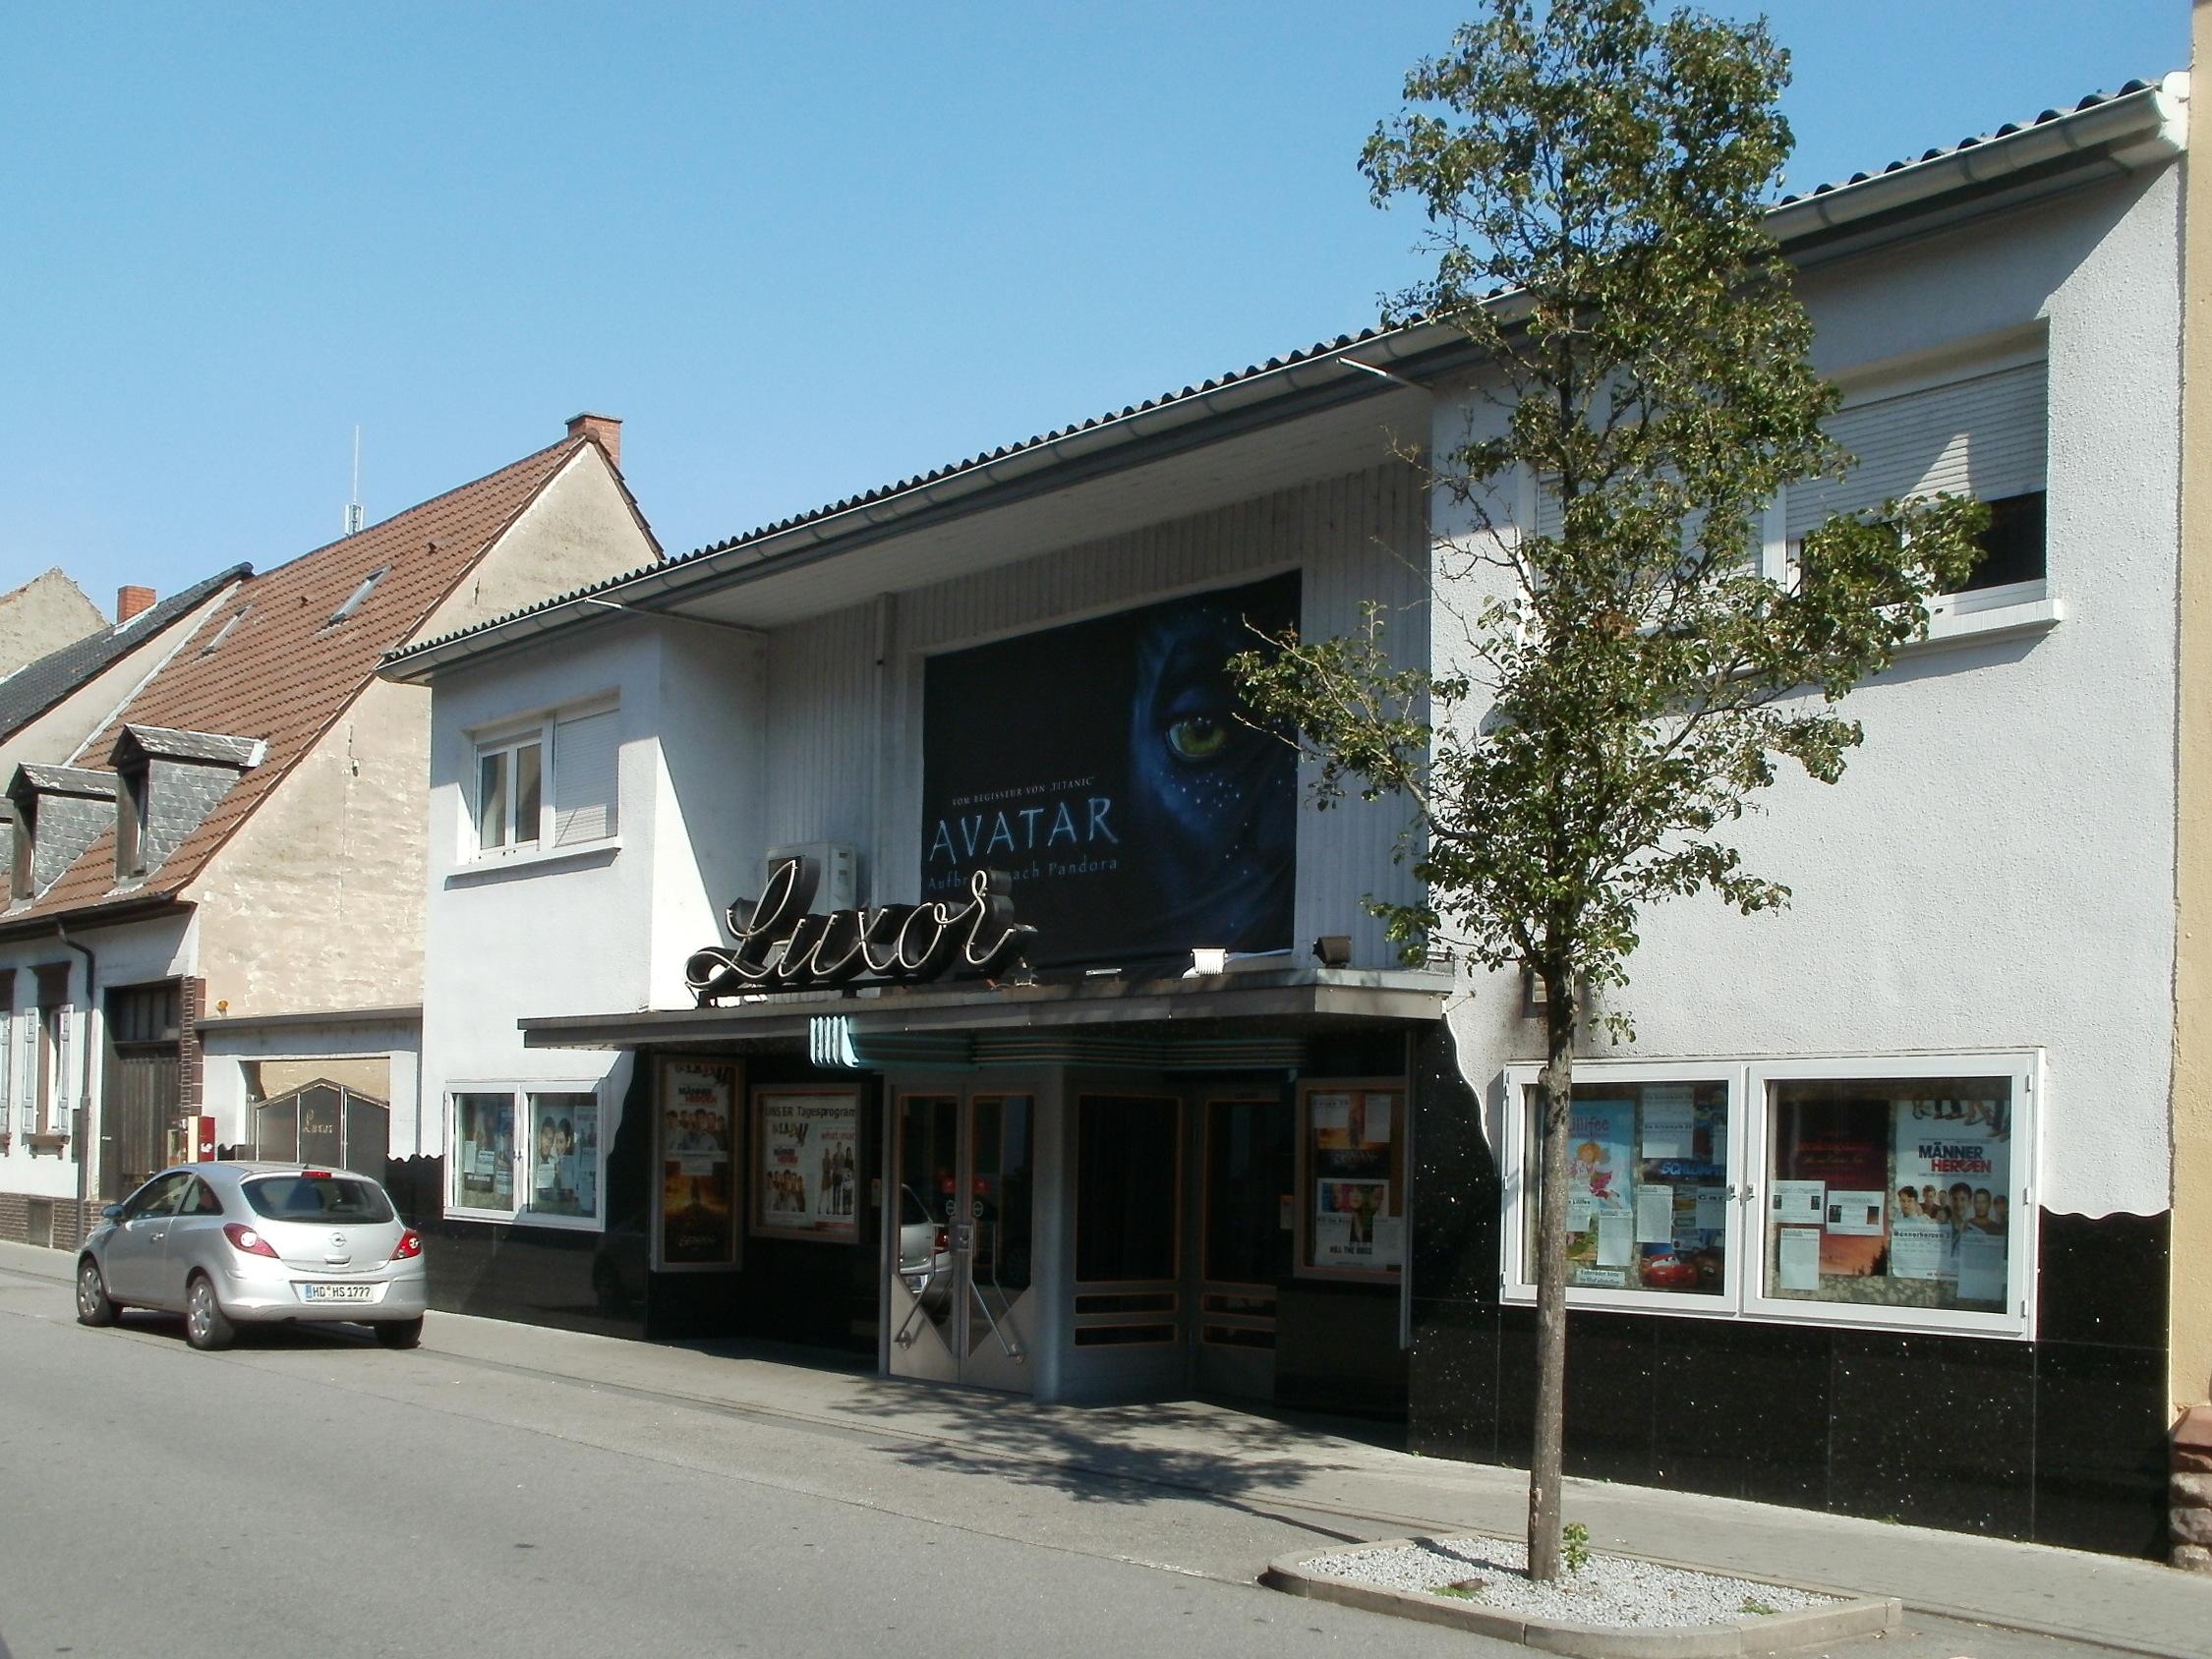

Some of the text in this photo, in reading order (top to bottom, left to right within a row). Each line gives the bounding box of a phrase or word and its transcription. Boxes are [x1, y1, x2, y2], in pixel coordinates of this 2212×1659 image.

[1025, 785, 1045, 795] VON
[929, 797, 1119, 865] AVATAR
[928, 870, 967, 889] Aufbr
[1048, 854, 1117, 877] Pandora
[685, 856, 1019, 990] Luxor
[1918, 1141, 1983, 1160] MÄNNER
[313, 1287, 371, 1297] HD HS 1777
